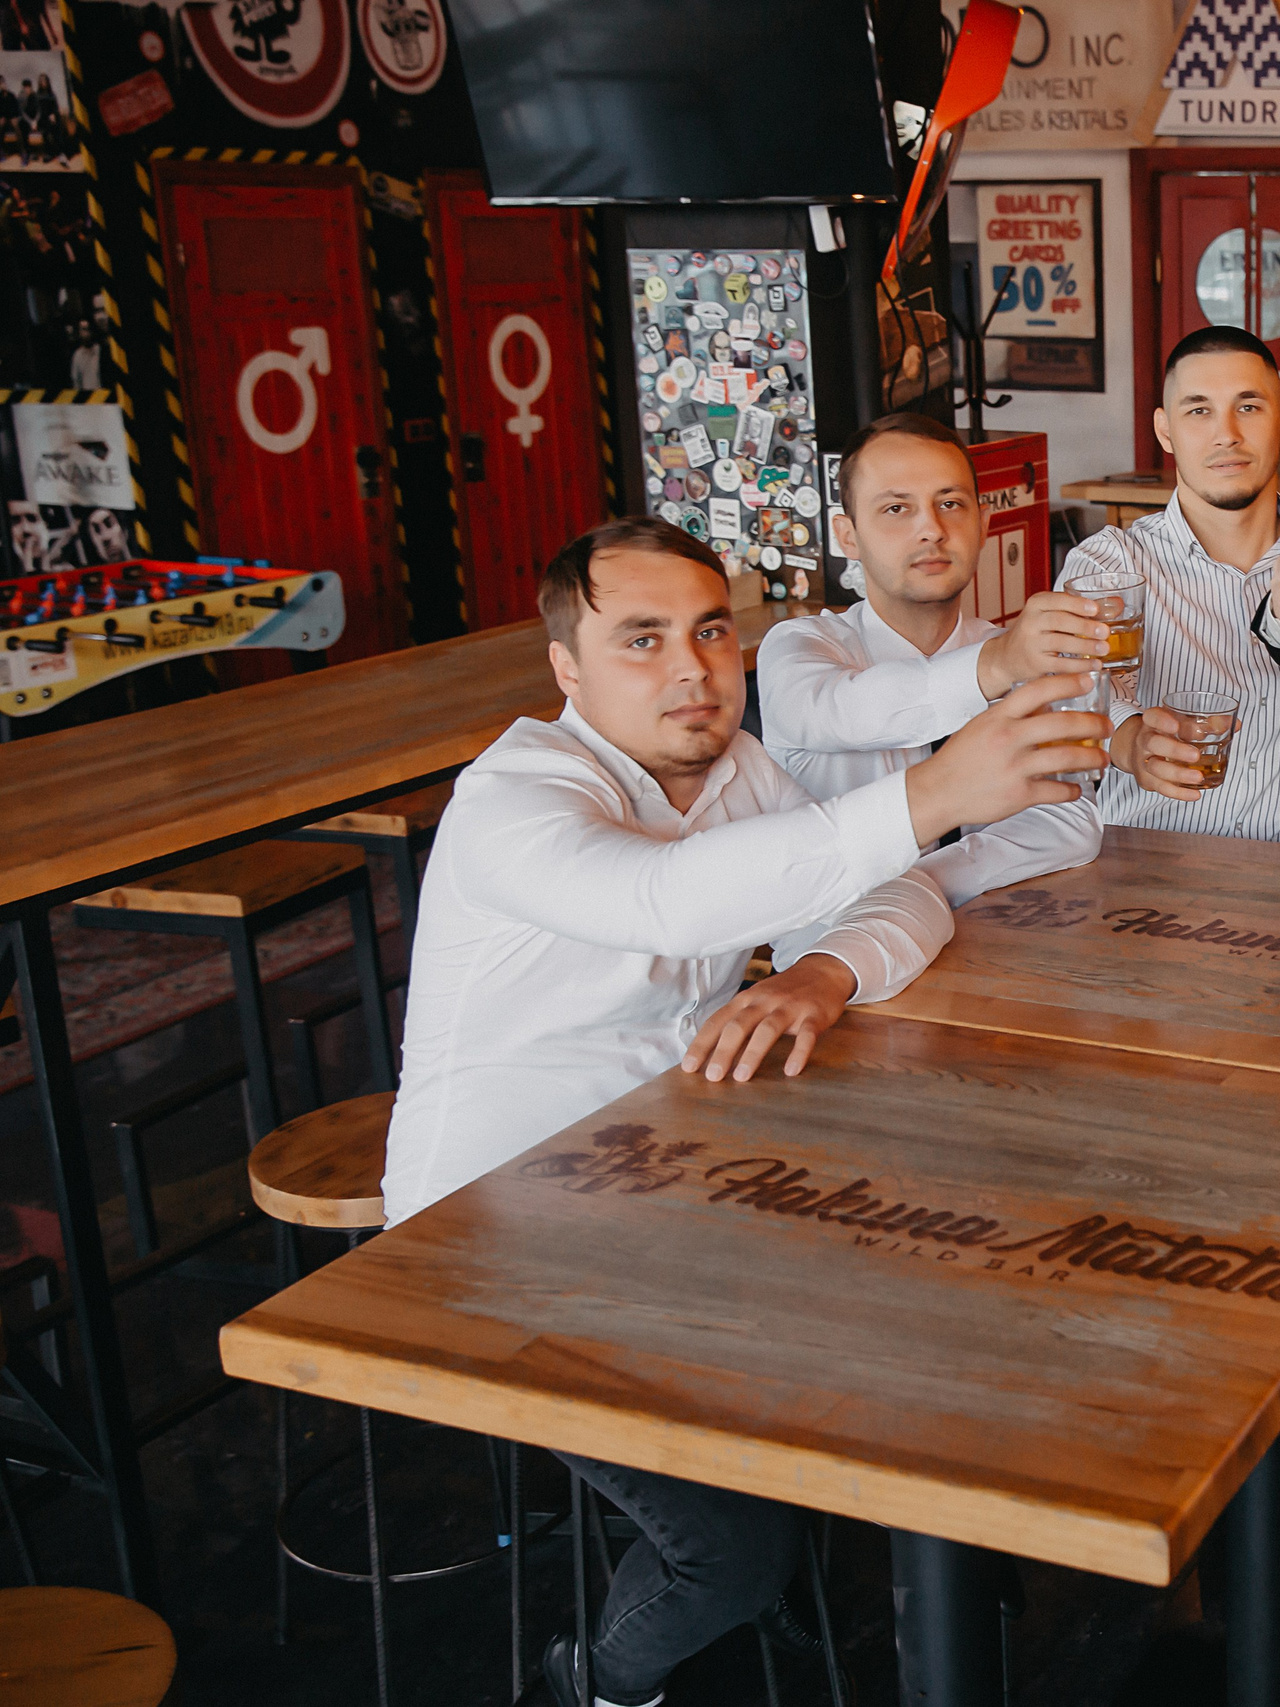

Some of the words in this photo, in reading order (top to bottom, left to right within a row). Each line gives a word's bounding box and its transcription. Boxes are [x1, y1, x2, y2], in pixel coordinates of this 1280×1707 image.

[1048, 108, 1129, 131] RENTALS
[995, 194, 1080, 214] QUALITY
[986, 219, 1082, 241] GREETING
[1009, 245, 1065, 263] CARDS
[36, 460, 120, 487] AWAKE
[705, 1158, 1009, 1246] Hakuna
[854, 1234, 959, 1261] WILD
[985, 1258, 1070, 1282] BAR
